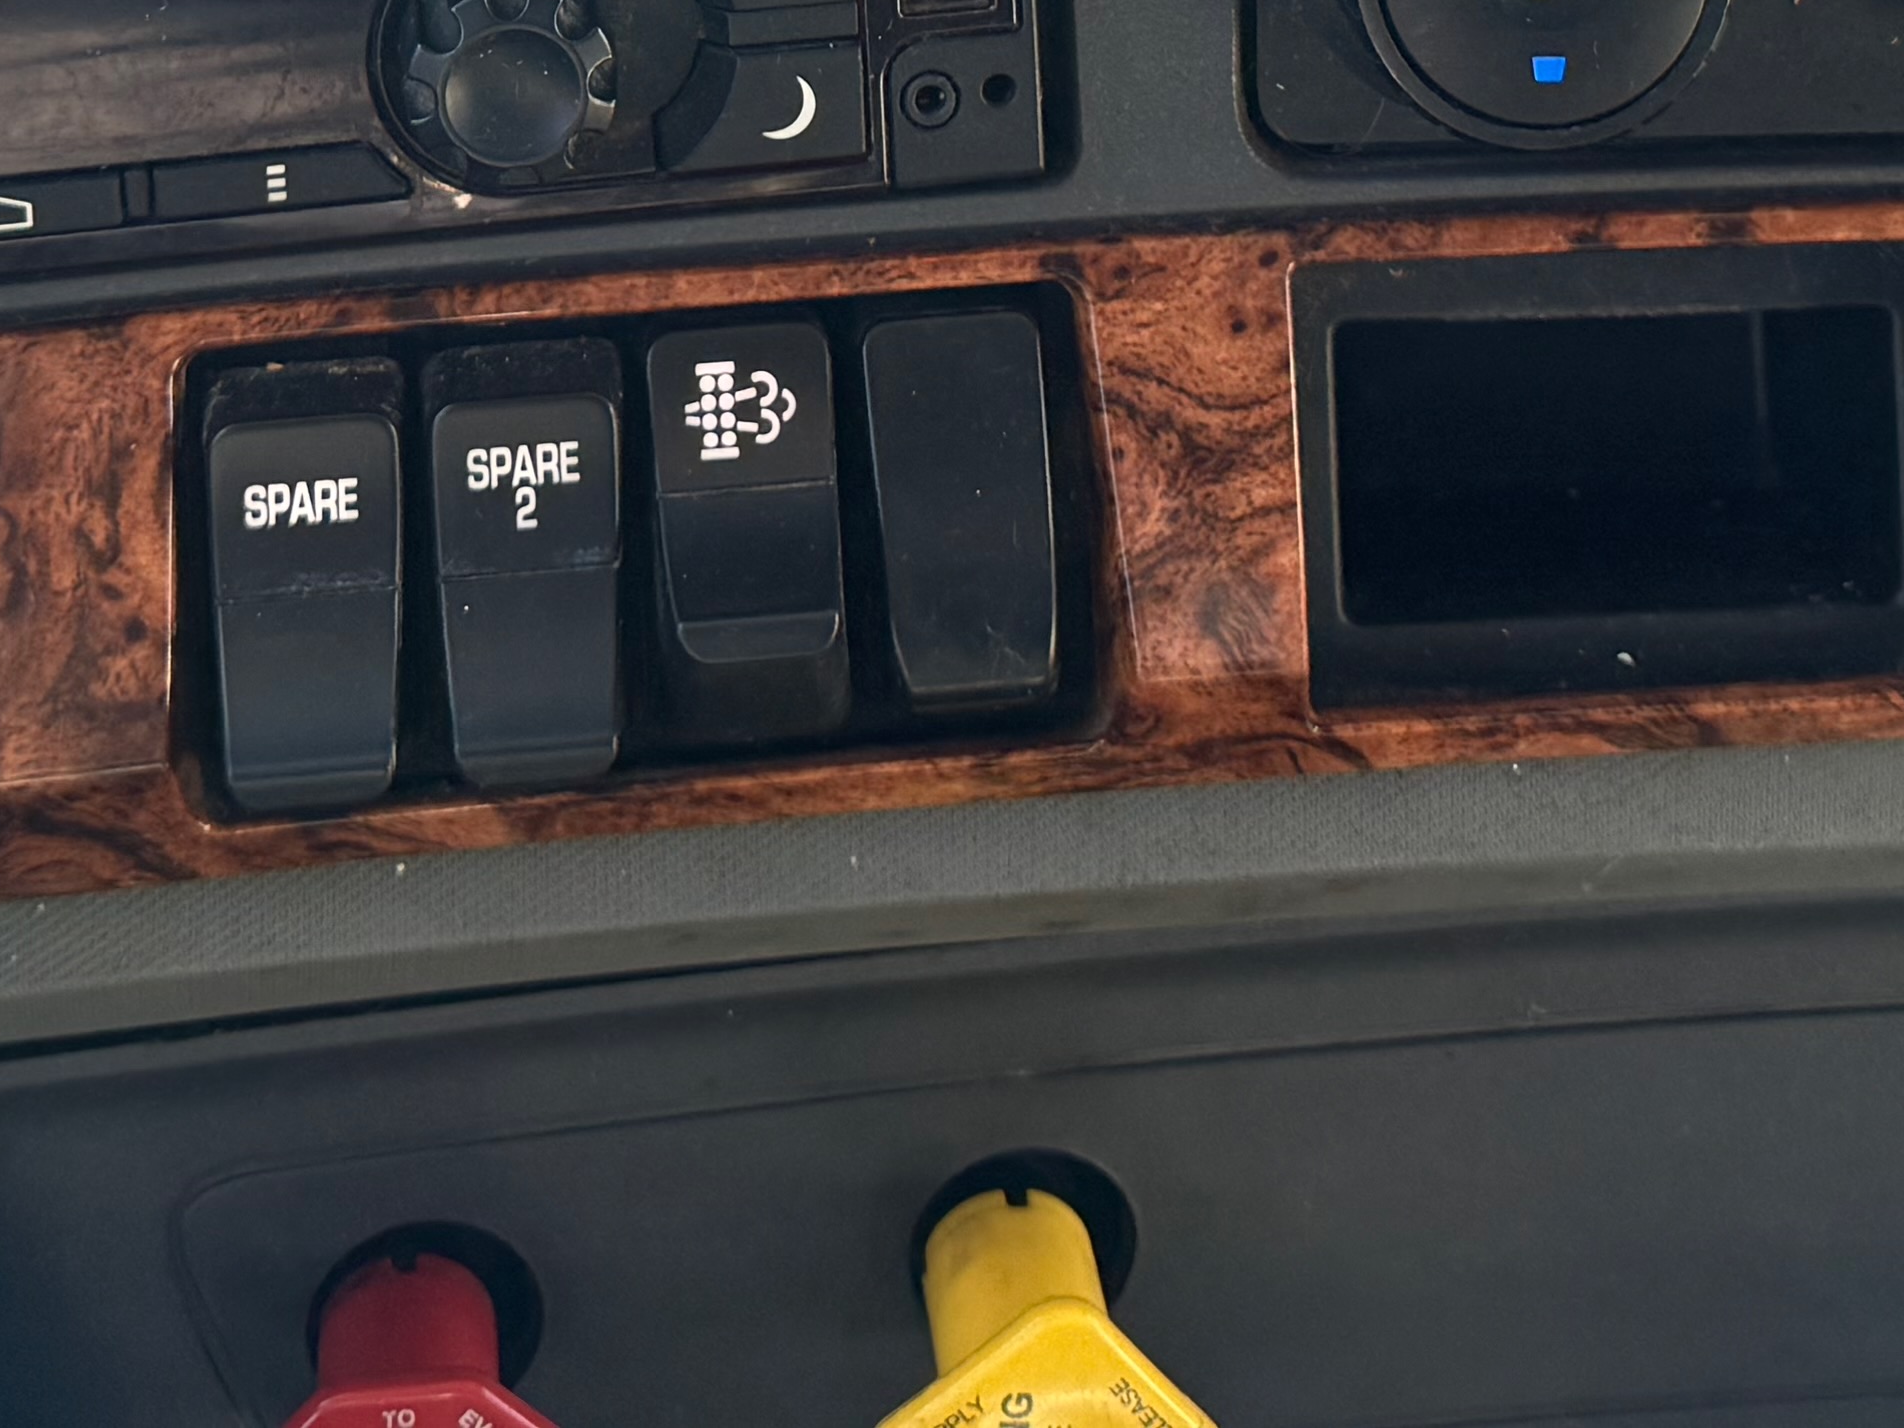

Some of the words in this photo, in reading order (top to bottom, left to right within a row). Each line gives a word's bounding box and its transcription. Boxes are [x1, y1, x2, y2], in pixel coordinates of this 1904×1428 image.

[467, 440, 582, 491] SPARE
[243, 477, 359, 530] SPARE
[515, 486, 539, 532] 2
